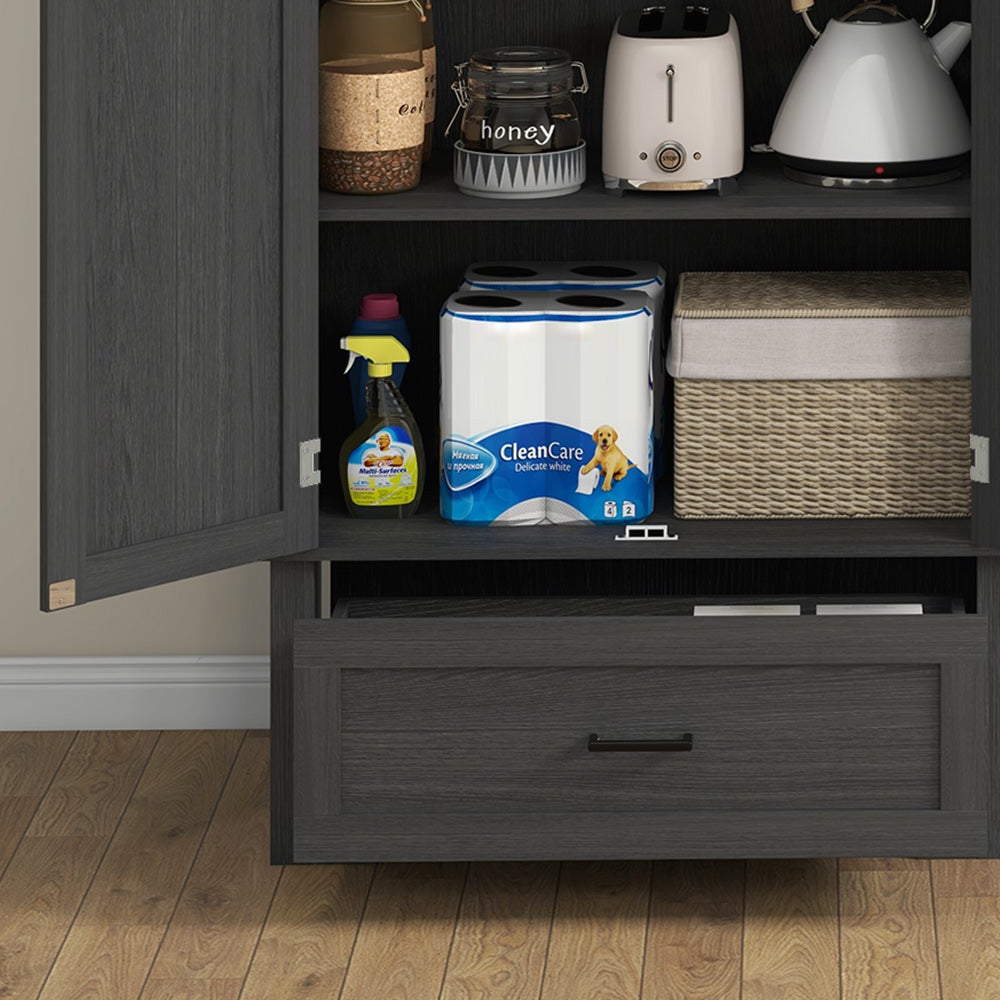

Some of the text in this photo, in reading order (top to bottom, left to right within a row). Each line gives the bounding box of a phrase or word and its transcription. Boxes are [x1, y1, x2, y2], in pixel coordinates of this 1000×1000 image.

[482, 120, 555, 145] honey
[452, 450, 478, 459] Мягкая
[500, 441, 584, 460] CleanCare
[454, 463, 484, 473] прочная
[515, 462, 571, 472] Delicate white
